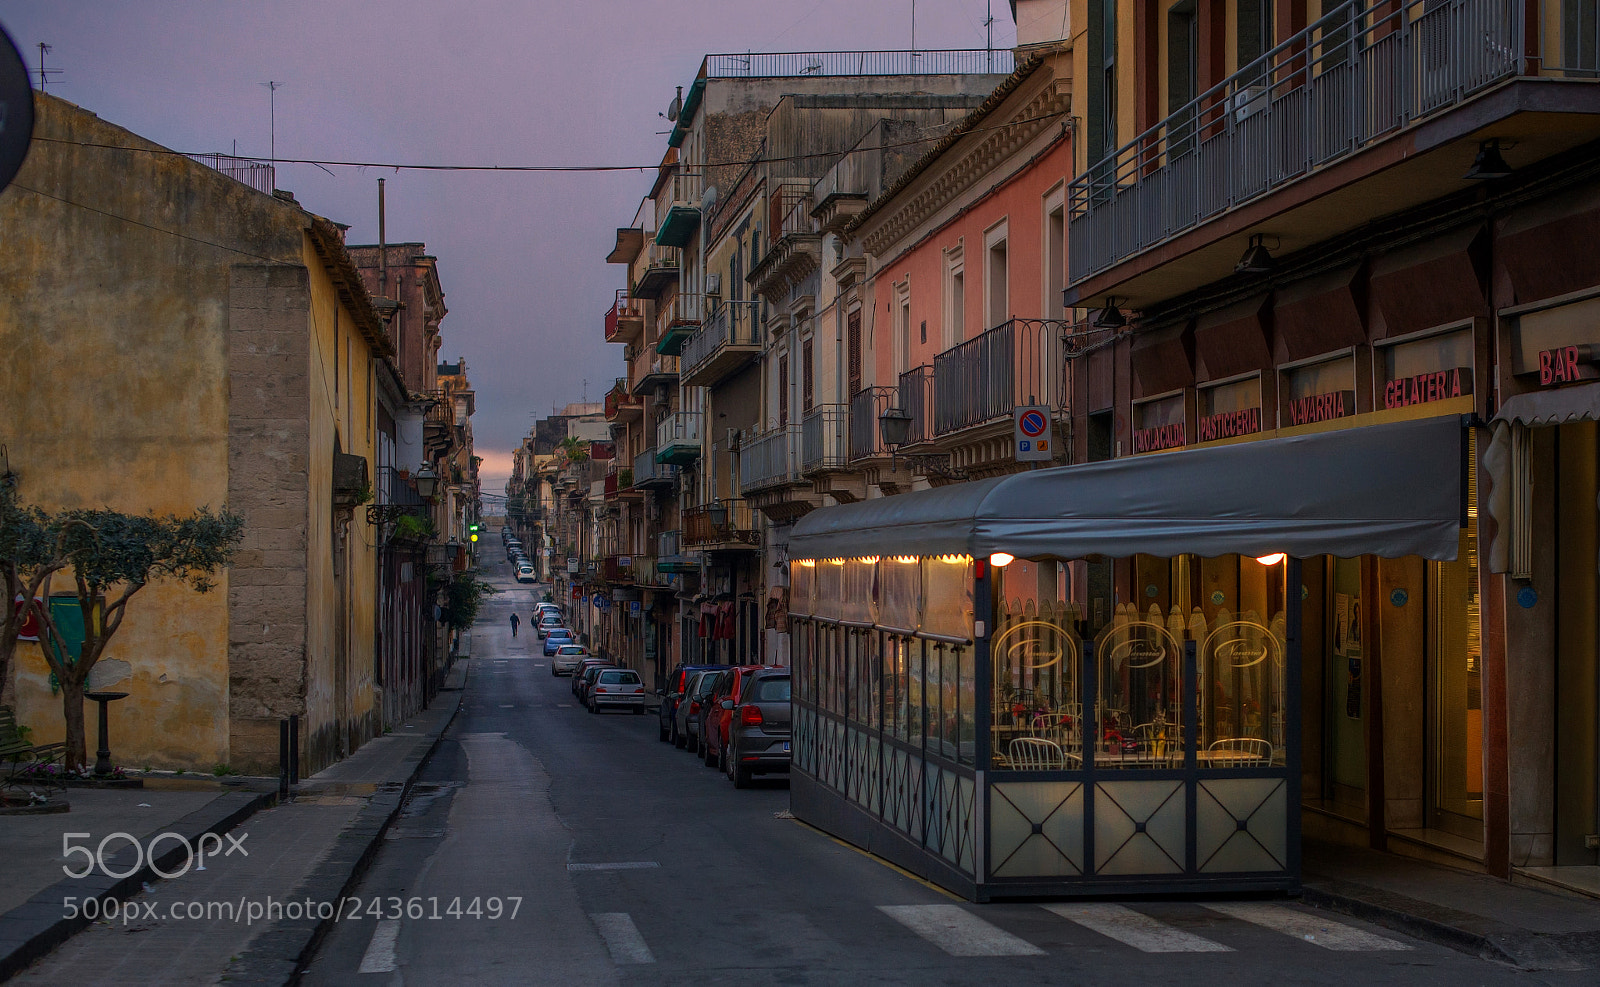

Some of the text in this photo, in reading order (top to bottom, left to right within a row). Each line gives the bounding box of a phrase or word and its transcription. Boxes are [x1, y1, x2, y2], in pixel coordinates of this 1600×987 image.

[1539, 346, 1580, 385] BAR
[1385, 368, 1462, 410] GELATERIA
[1201, 408, 1259, 441] PASTICCERIA
[1289, 391, 1345, 426] NAVARRIA
[1160, 423, 1184, 449] CALDA
